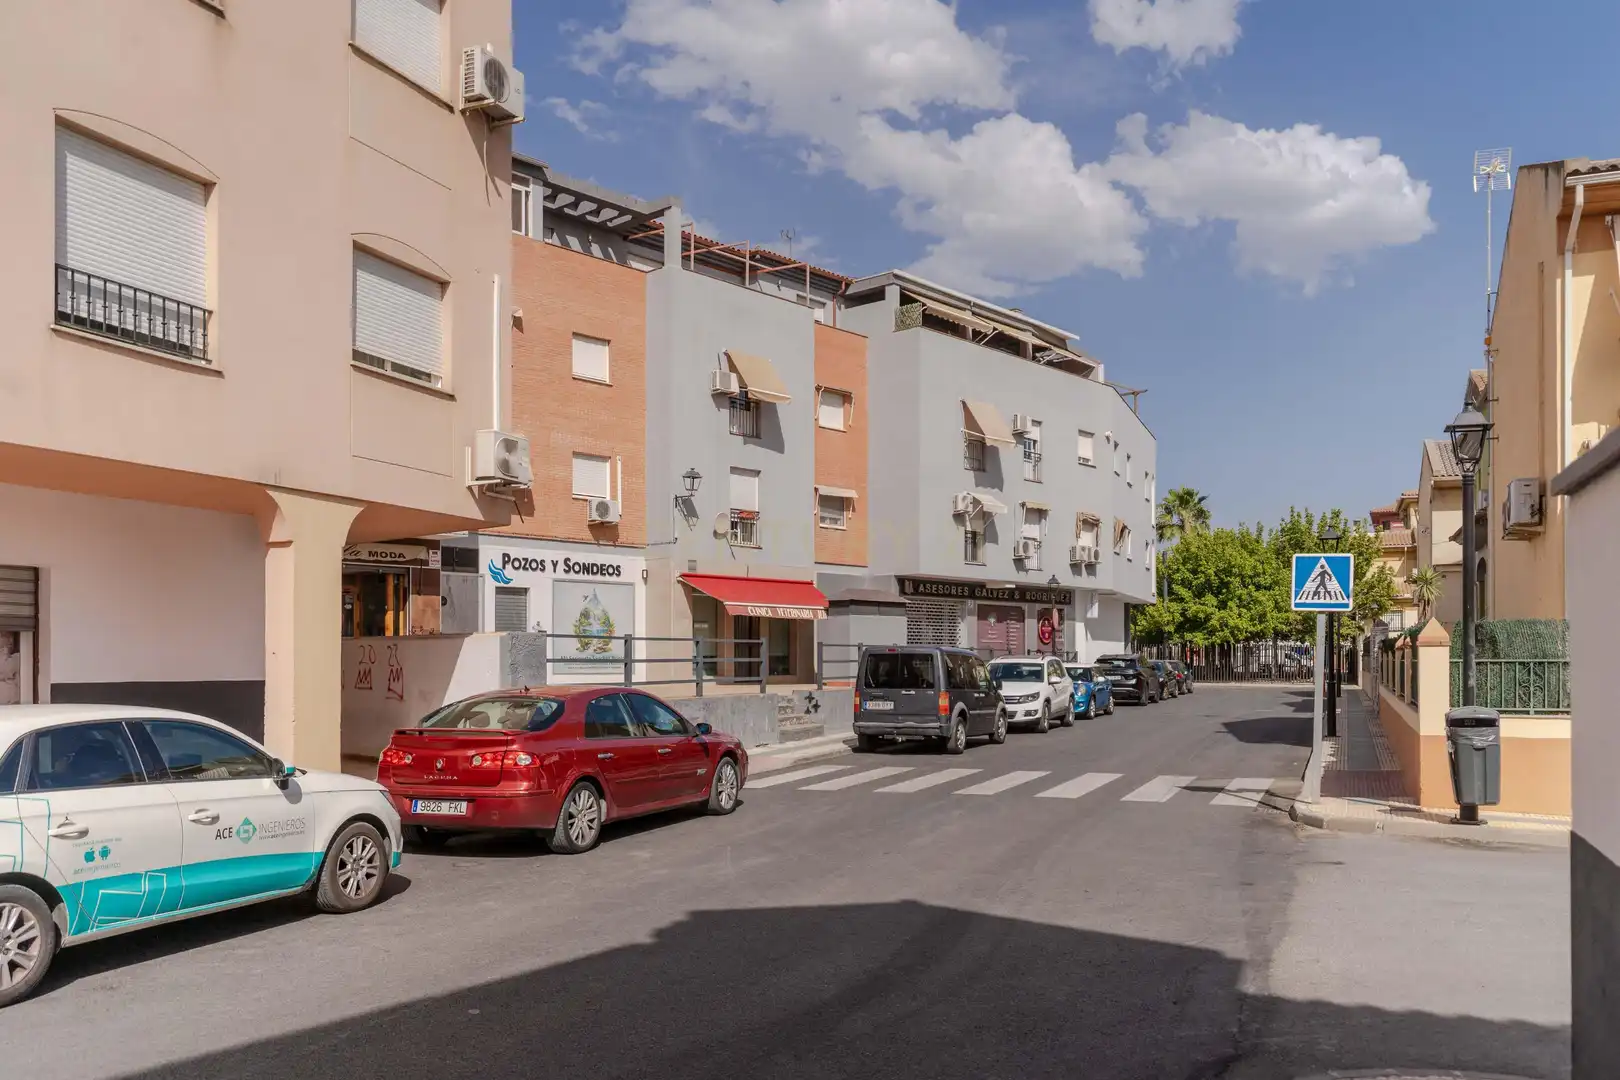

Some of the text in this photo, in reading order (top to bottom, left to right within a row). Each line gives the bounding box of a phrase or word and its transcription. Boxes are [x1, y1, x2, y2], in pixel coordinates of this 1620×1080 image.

[367, 550, 407, 559] MODA
[501, 552, 622, 577] POZOS Y SONDEOS
[918, 583, 969, 596] ASESORES
[1014, 589, 1021, 600] &
[1025, 591, 1071, 602] RODRIEZ
[420, 801, 465, 813] 9826 FKL
[214, 817, 306, 841] ACE INGENIEROS
